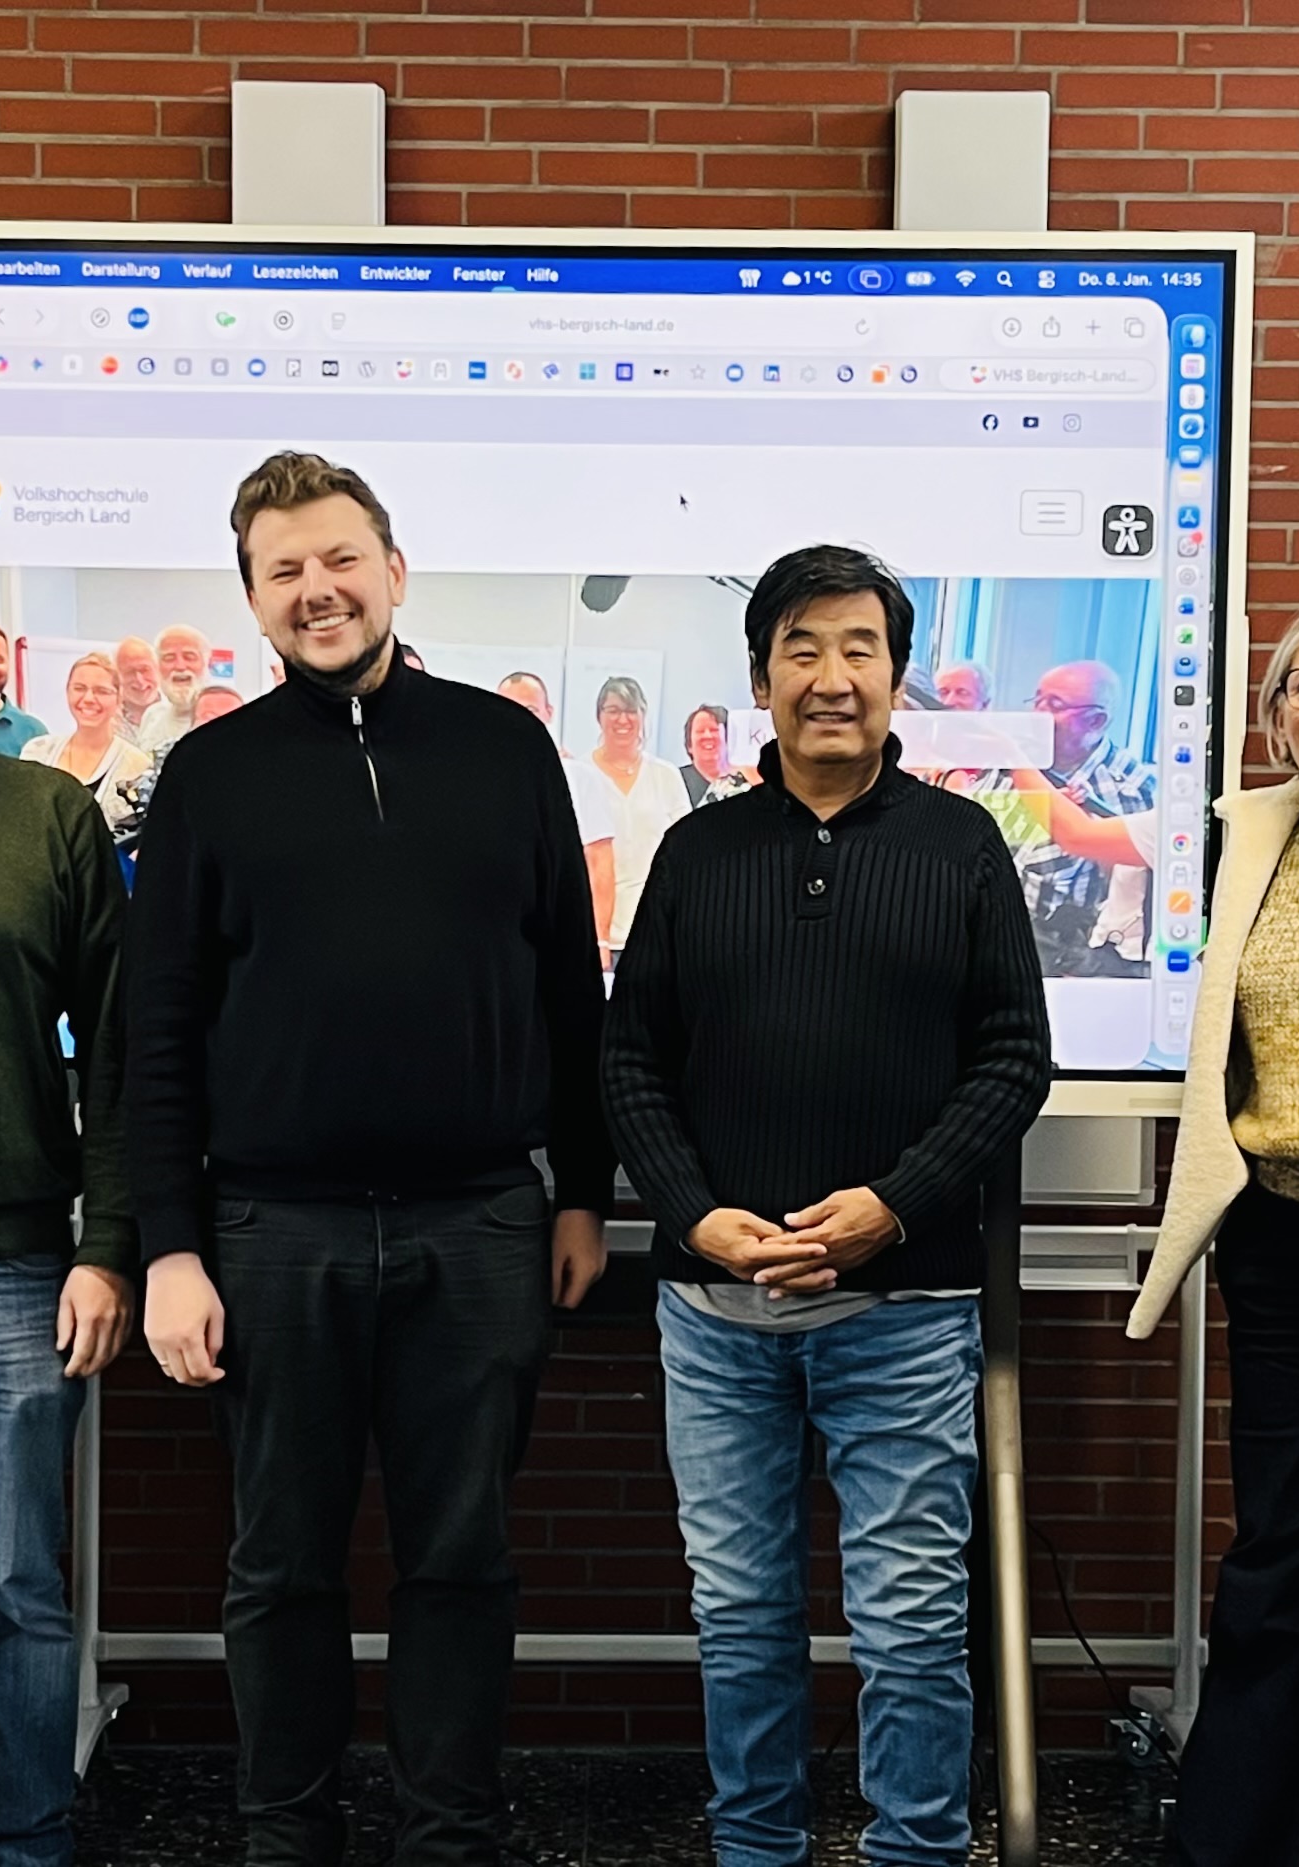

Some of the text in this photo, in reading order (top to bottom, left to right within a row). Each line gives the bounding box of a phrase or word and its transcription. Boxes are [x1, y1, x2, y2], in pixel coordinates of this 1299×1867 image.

[81, 261, 161, 280] Darstellung
[182, 263, 232, 279] Verlauf
[252, 264, 339, 280] Lesezeichen
[360, 265, 432, 281] Entwickler
[453, 266, 506, 282] Fenster
[526, 267, 559, 283] Hilfe
[1078, 271, 1202, 287] Do. 8. Jan. 14:35
[528, 317, 675, 333] vhs-bergisch-land.de
[993, 369, 1023, 382] VHS
[13, 485, 149, 503] Volkshochschule
[13, 507, 131, 526] Bergisch Land
